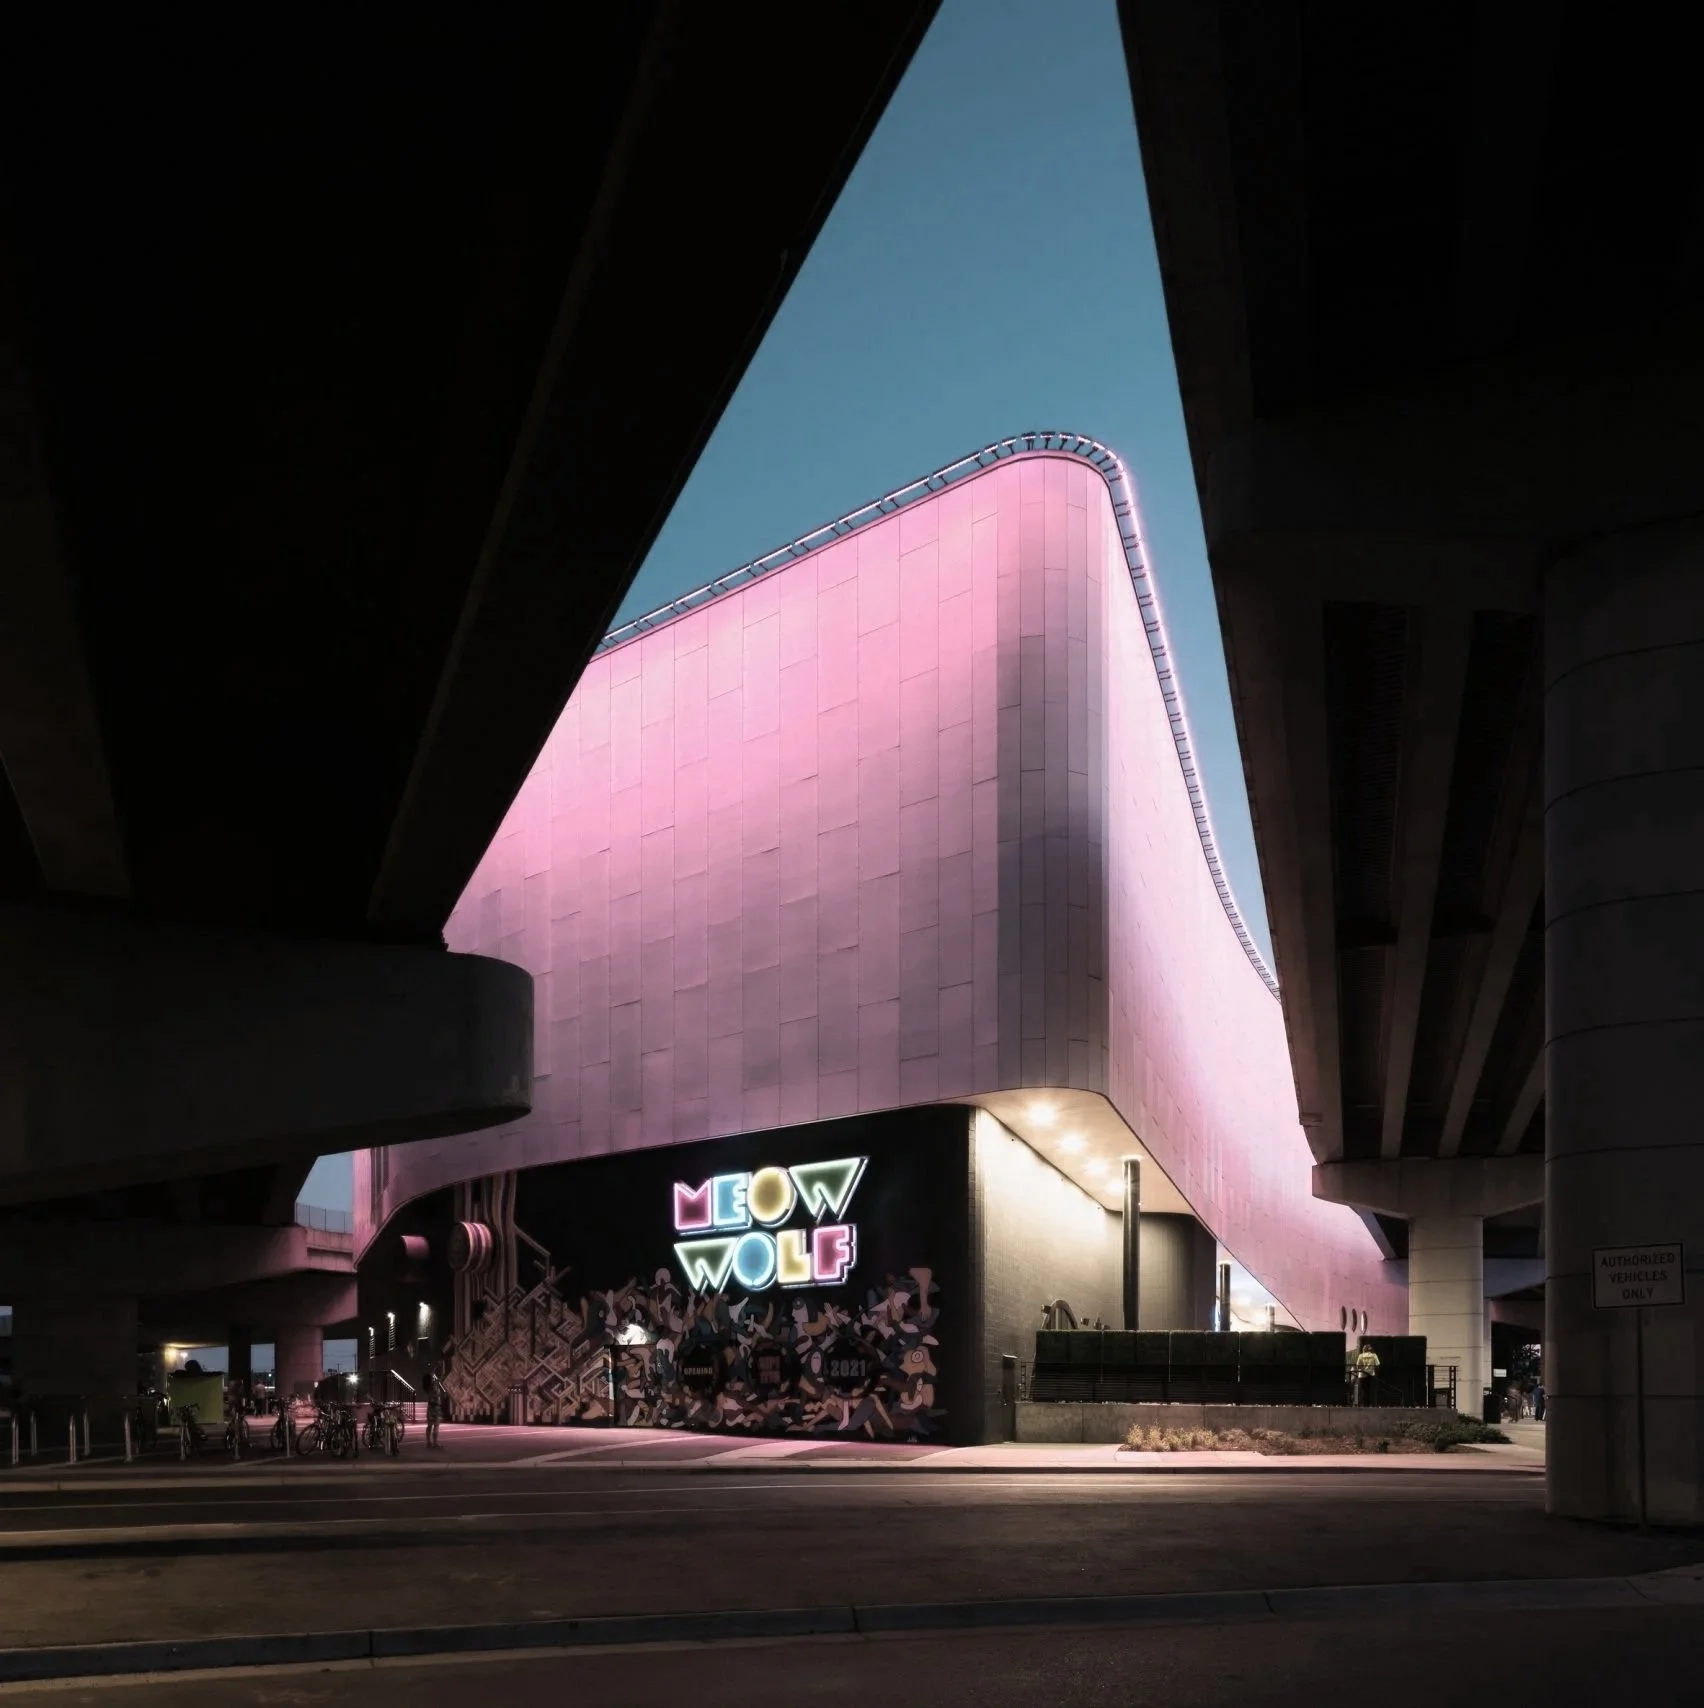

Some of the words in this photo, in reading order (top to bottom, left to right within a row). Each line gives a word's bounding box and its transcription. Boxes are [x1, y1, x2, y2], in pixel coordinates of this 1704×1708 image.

[673, 1155, 870, 1235] MEOW
[673, 1223, 858, 1295] WOLF
[1600, 1253, 1675, 1268] AUTHORIZED
[1609, 1270, 1668, 1284] VEHICLES
[1622, 1287, 1654, 1300] ONLY
[830, 1359, 866, 1377] 2021
